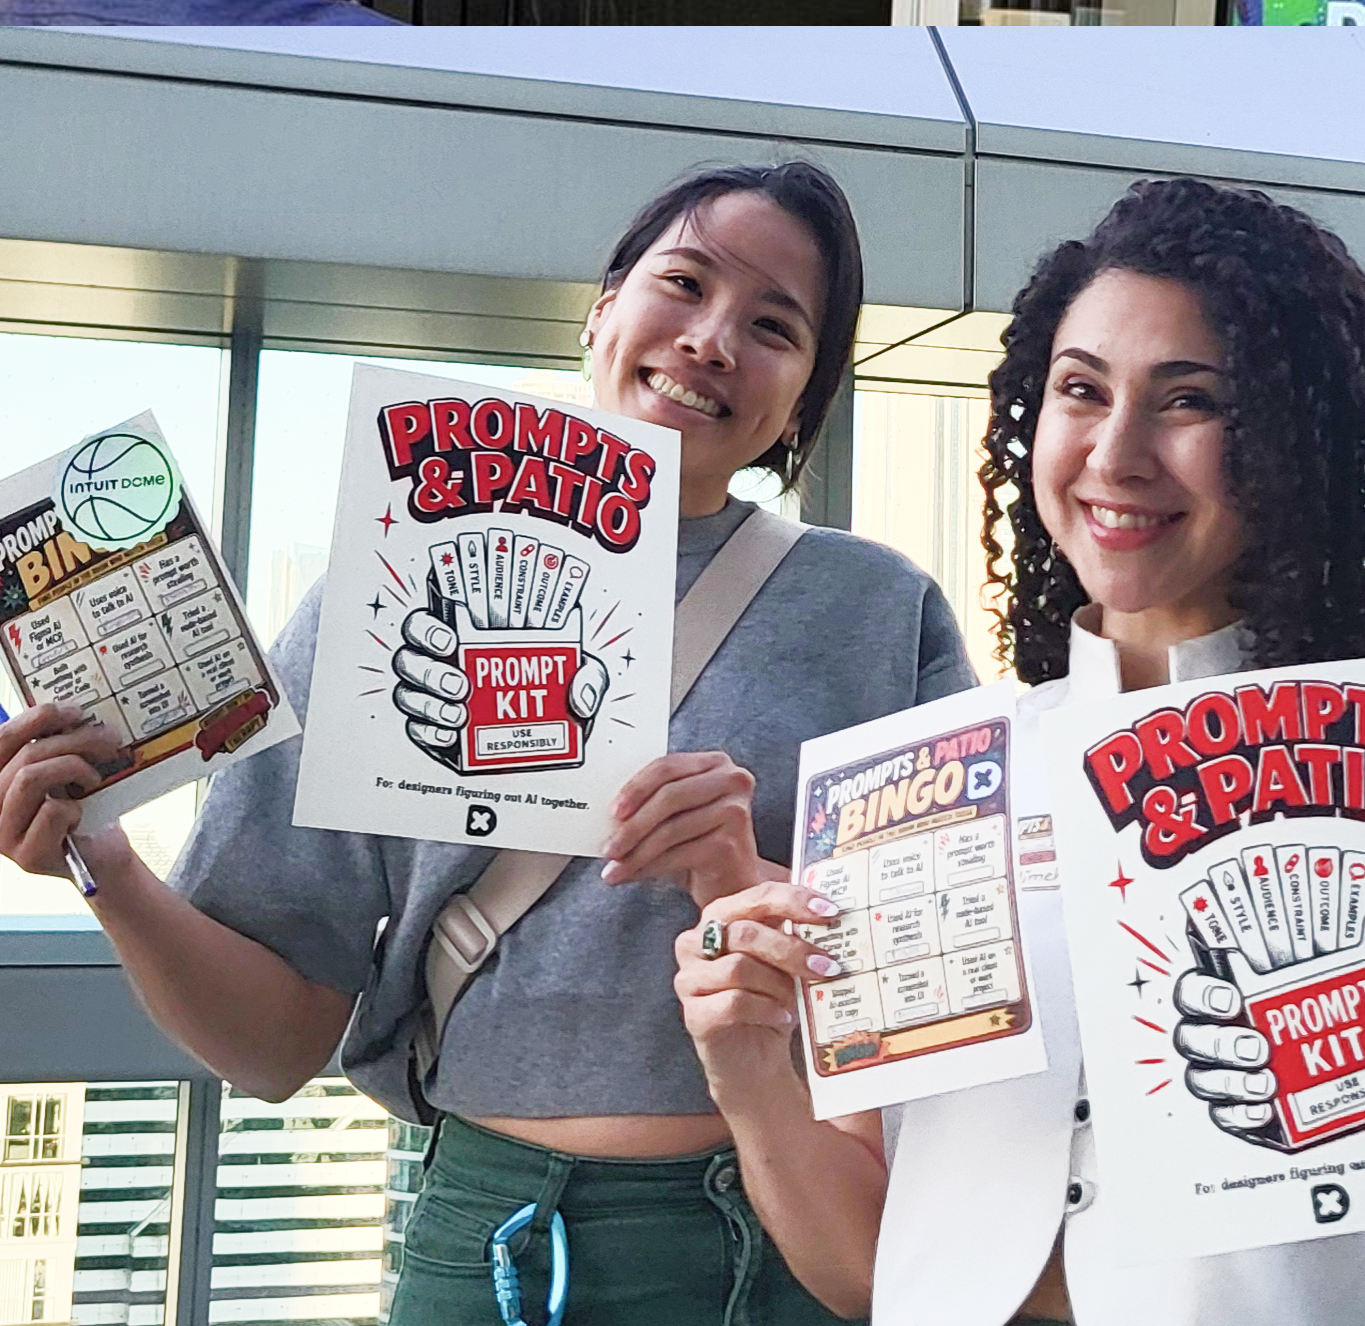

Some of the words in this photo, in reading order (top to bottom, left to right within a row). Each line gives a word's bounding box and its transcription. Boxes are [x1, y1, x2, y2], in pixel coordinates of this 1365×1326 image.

[378, 397, 656, 503] PROMPTS
[408, 457, 467, 524] &
[470, 451, 642, 554] PATIO
[0, 510, 58, 572] PROMP
[16, 531, 94, 600] BIN
[444, 569, 460, 596] TONE
[468, 562, 482, 594] STYLE
[493, 554, 505, 601] AUDIENCE
[513, 559, 529, 615] CONSTRAINT
[89, 594, 108, 607] Uses
[532, 571, 551, 613] OUTCOME
[551, 581, 574, 623] EXAMPLES
[475, 655, 567, 688] PROMPT
[496, 689, 548, 720] KIT
[486, 737, 557, 752] RESPONSIBLY
[511, 728, 532, 739] USE
[398, 780, 453, 795] designers
[456, 785, 501, 804] figuring
[504, 793, 522, 804] out
[525, 794, 538, 805] AI
[825, 751, 915, 816] PROMPTS
[916, 746, 932, 771] &
[932, 727, 993, 767] PATIO
[834, 760, 966, 848] BINGO
[1140, 783, 1208, 869] &
[1230, 896, 1253, 934] STYLE
[1258, 876, 1280, 932] AUDIENCE
[1289, 873, 1307, 941] CONSTRAINT
[1319, 880, 1330, 932] OUTCOME
[1344, 883, 1362, 939] EXAMPLES
[1204, 912, 1228, 944] TONE
[1300, 1026, 1365, 1077] KIT
[1335, 1076, 1360, 1092] USE
[1221, 1170, 1286, 1192] designers
[1289, 1161, 1345, 1181] figuring
